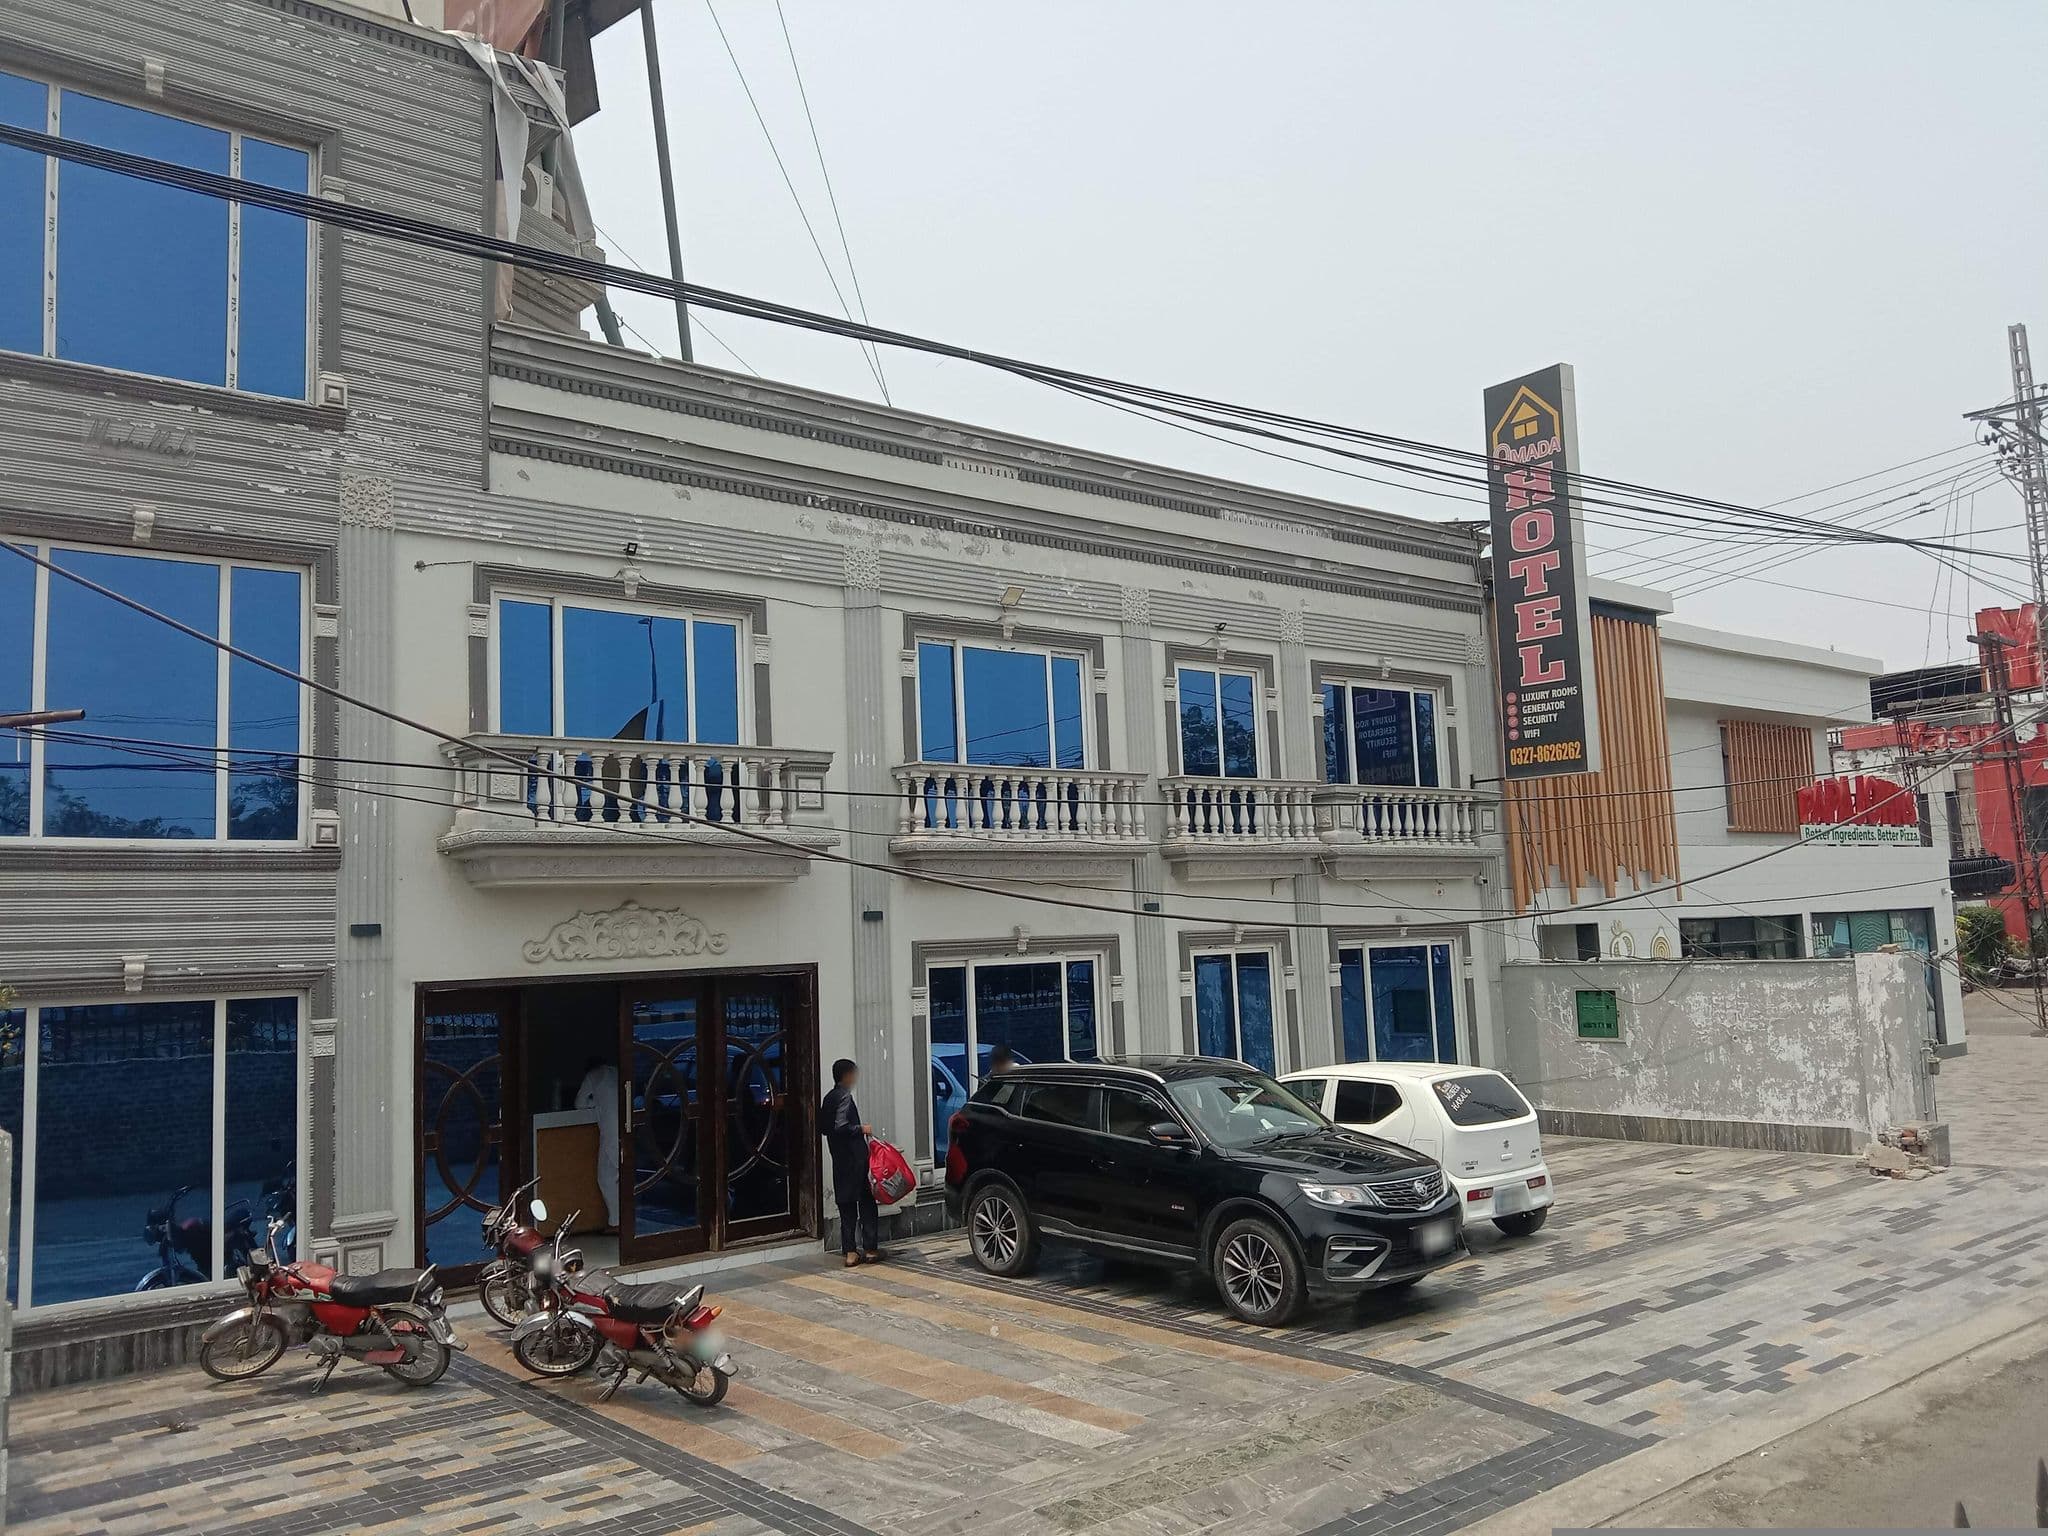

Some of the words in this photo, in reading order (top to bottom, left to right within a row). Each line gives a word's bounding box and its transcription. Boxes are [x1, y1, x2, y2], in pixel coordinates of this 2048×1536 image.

[1503, 460, 1567, 687] HOTEL
[1521, 690, 1550, 702] LUXURY
[1552, 686, 1578, 697] ROOMS
[1522, 701, 1566, 714] GENERATOR
[1523, 713, 1558, 726] SECURITY
[1523, 729, 1540, 738] WIFI
[1510, 741, 1581, 766] 0327-8626262
[1832, 828, 1876, 843] Ingredients.
[1878, 828, 1899, 841] Better
[1900, 828, 1920, 841] Pizza.
